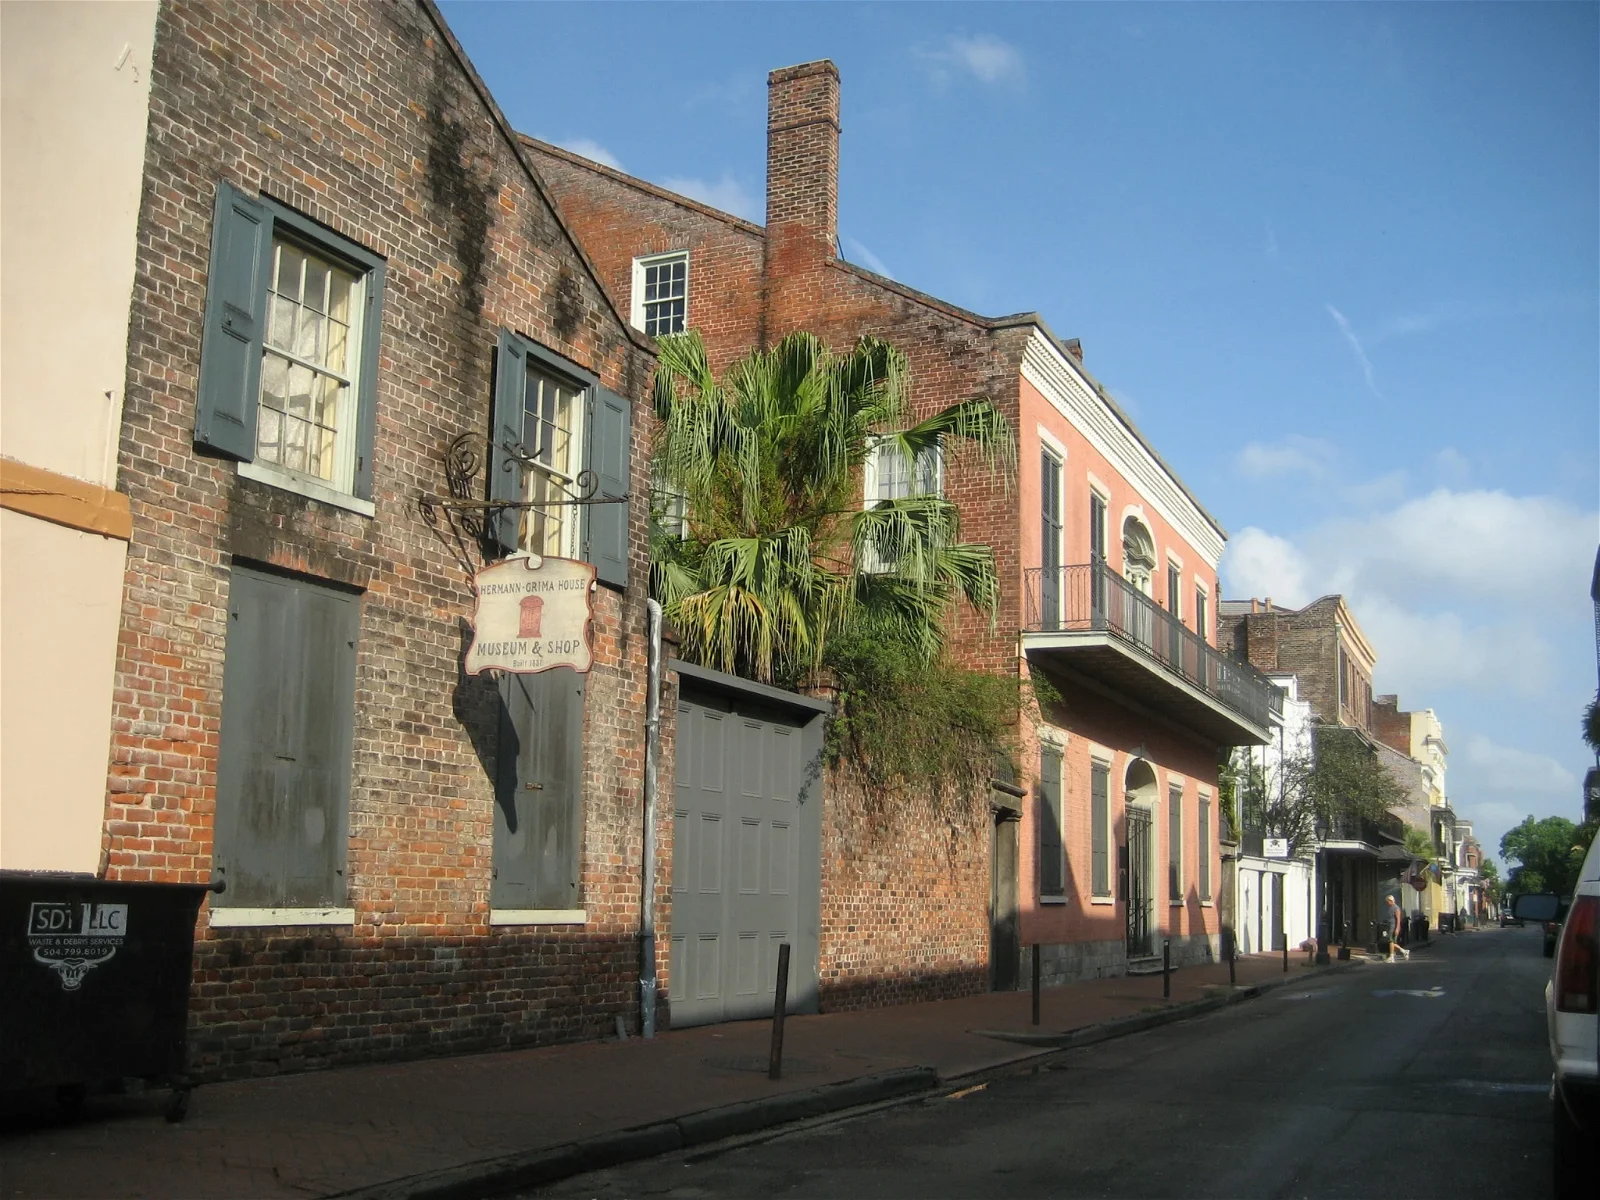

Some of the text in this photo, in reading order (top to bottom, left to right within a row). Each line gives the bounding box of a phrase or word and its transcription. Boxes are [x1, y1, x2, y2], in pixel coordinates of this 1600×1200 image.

[480, 578, 586, 595] HERMANN-GRIMA HOUSE
[477, 639, 581, 658] MUSEUM & SHOP
[88, 909, 121, 930] LLC
[29, 938, 124, 946] WASTE & DEBRIS SERVICES
[43, 948, 108, 956] 504.799.8019
